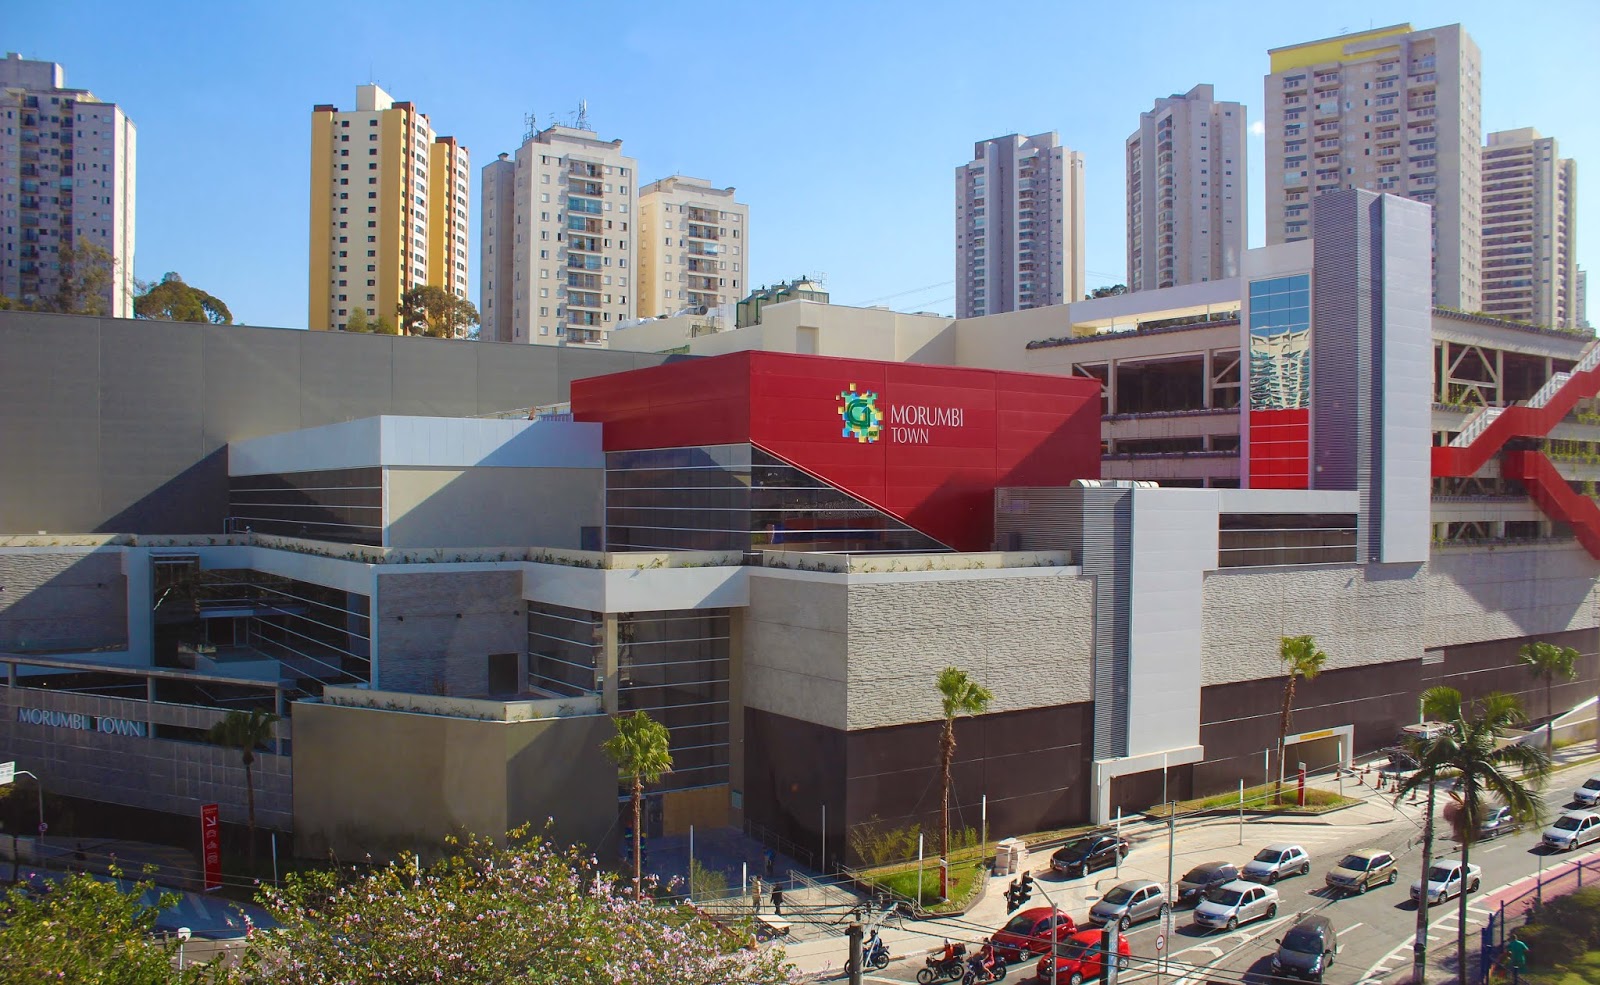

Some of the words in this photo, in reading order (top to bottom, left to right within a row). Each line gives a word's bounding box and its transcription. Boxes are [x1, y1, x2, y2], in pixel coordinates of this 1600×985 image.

[891, 405, 963, 427] MORUMBI
[892, 427, 929, 444] TOWN
[19, 708, 85, 730] MORUMBI
[94, 716, 140, 737] TOWN
